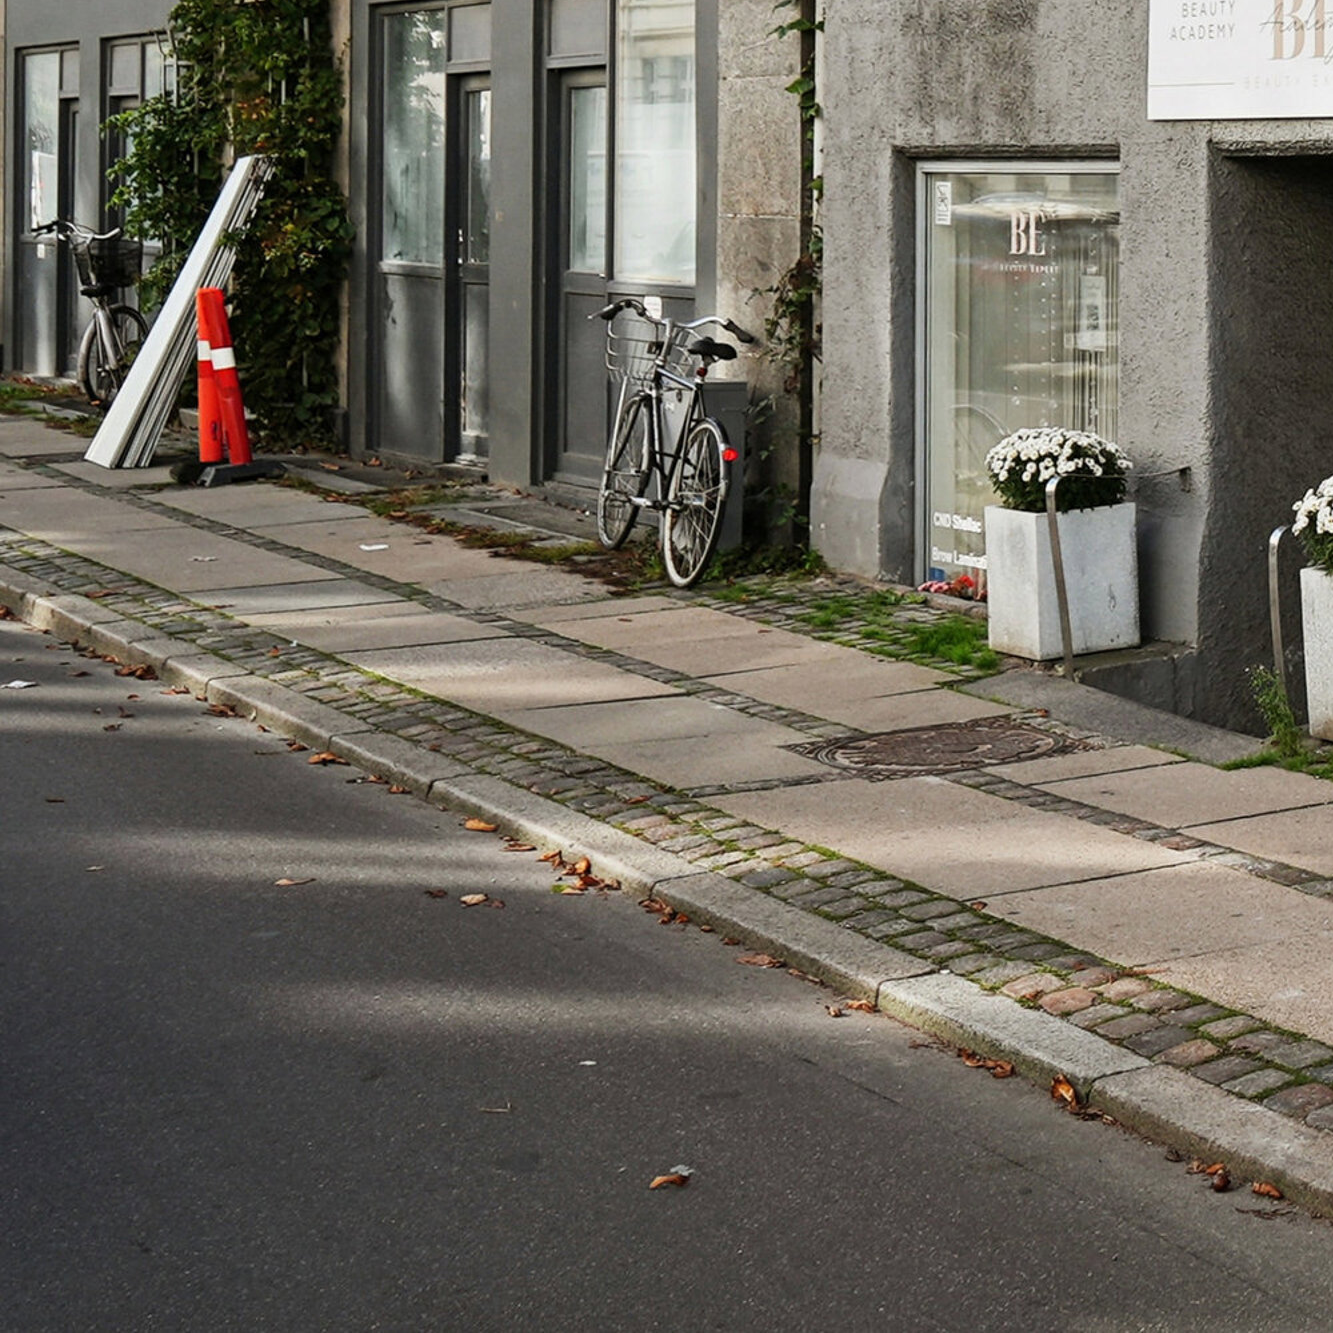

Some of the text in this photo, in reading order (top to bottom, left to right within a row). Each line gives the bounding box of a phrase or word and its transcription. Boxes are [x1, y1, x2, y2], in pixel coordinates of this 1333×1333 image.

[1181, 0, 1236, 19] BEAUTY
[1169, 23, 1236, 42] ACADEMY
[1009, 210, 1046, 256] BE
